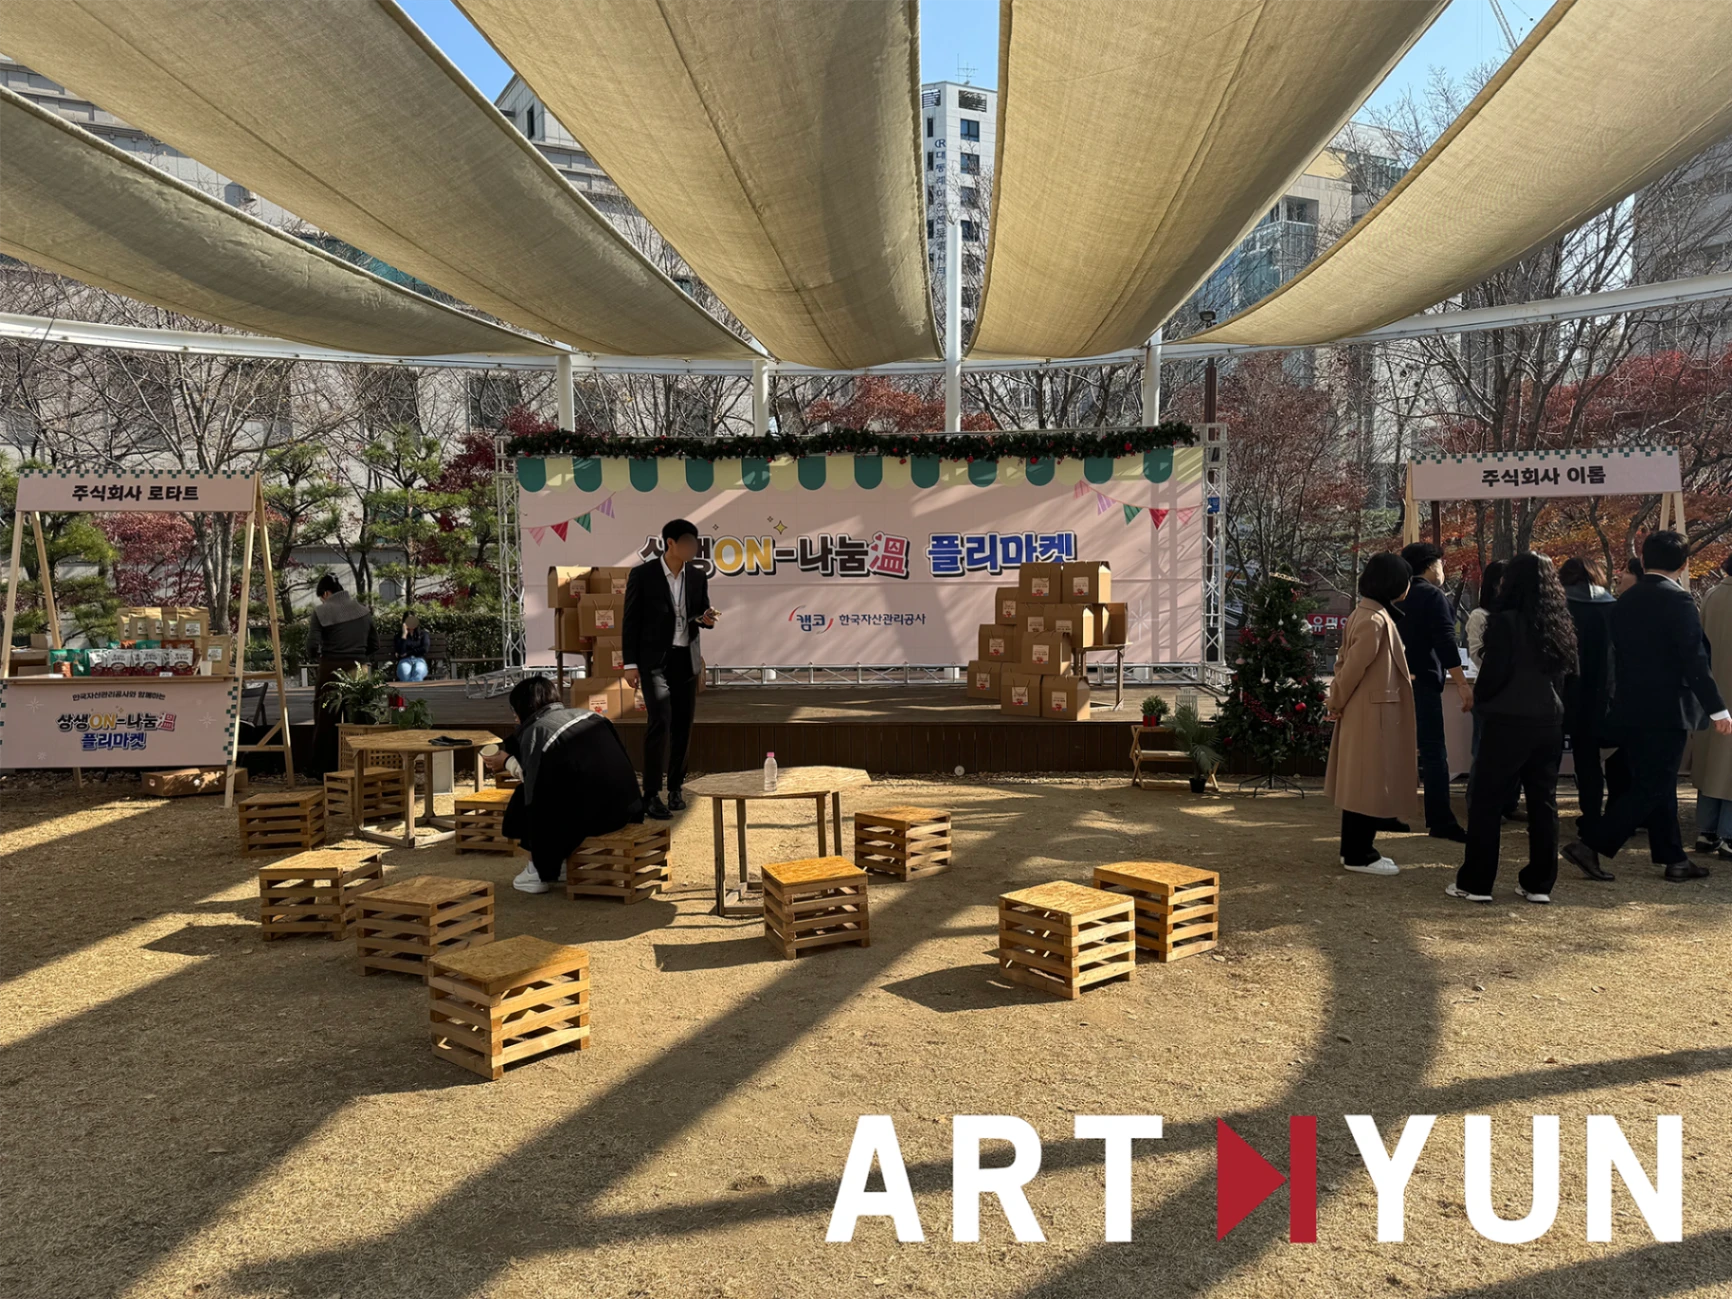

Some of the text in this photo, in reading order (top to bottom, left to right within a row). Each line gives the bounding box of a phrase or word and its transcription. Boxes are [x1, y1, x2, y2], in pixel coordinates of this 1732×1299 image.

[1481, 468, 1560, 487] 주식회사
[72, 484, 199, 502] 주식회사 로타트
[796, 612, 926, 632] 캠코 한국자산관리공사
[81, 731, 147, 751] 플리마켓
